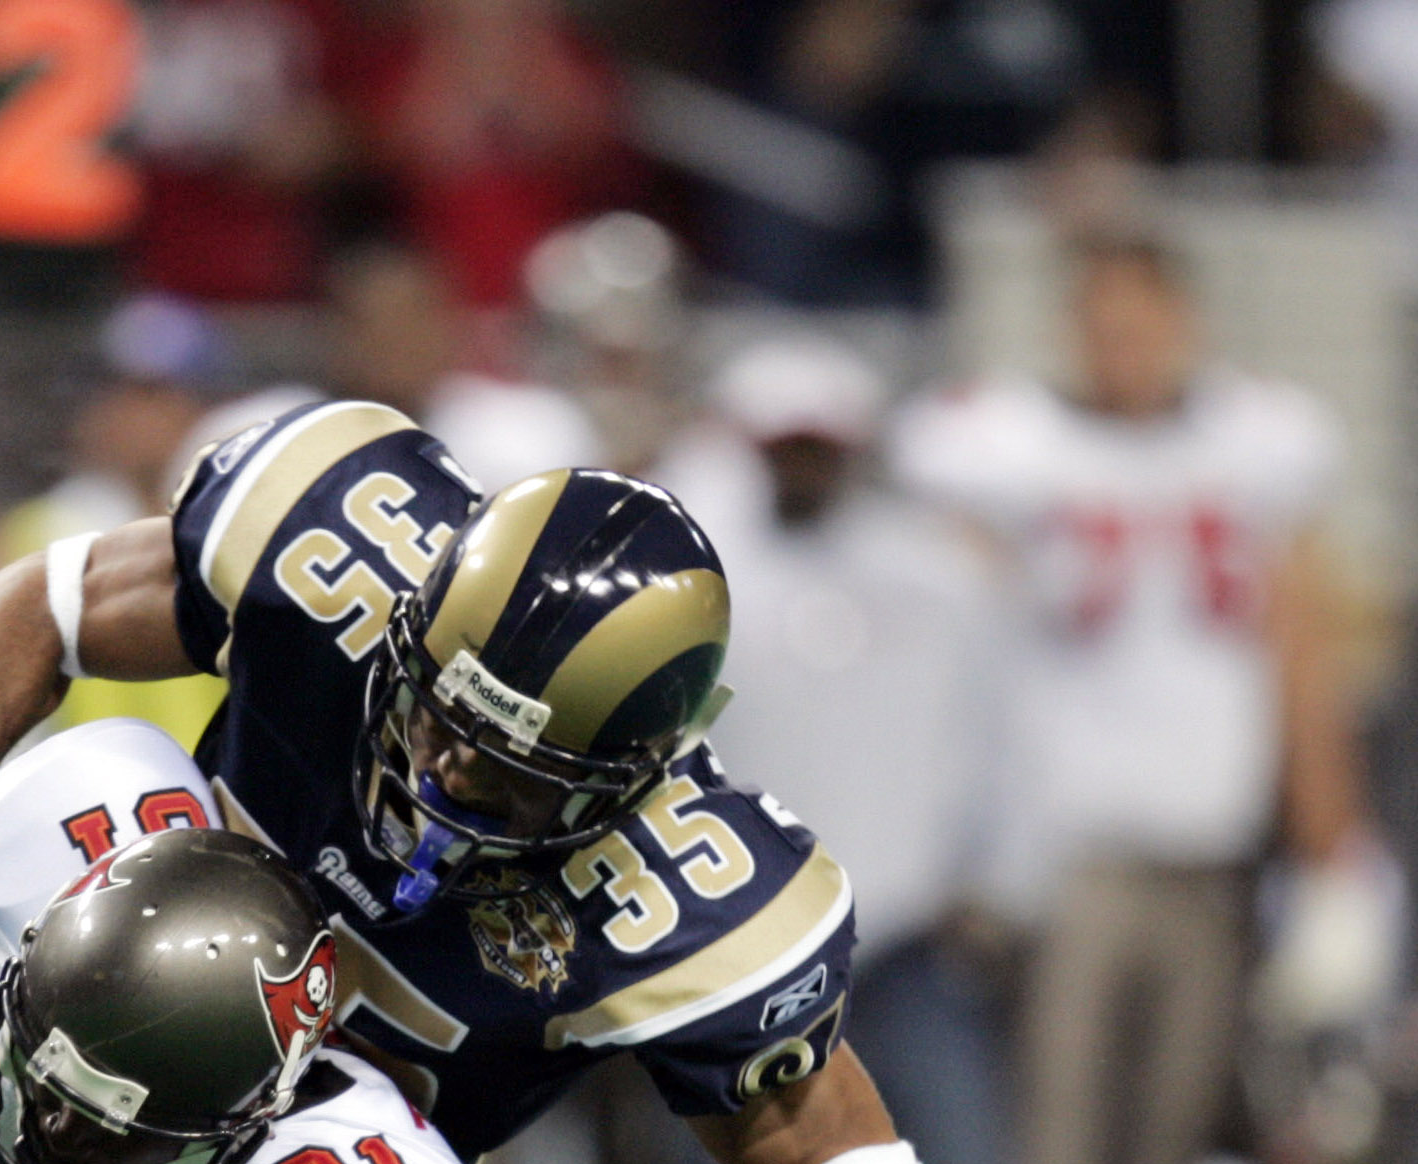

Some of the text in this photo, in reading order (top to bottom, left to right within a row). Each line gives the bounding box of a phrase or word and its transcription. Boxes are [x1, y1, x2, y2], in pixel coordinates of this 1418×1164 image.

[274, 471, 456, 662] 35
[469, 671, 522, 717] Riddell
[561, 773, 756, 954] 35
